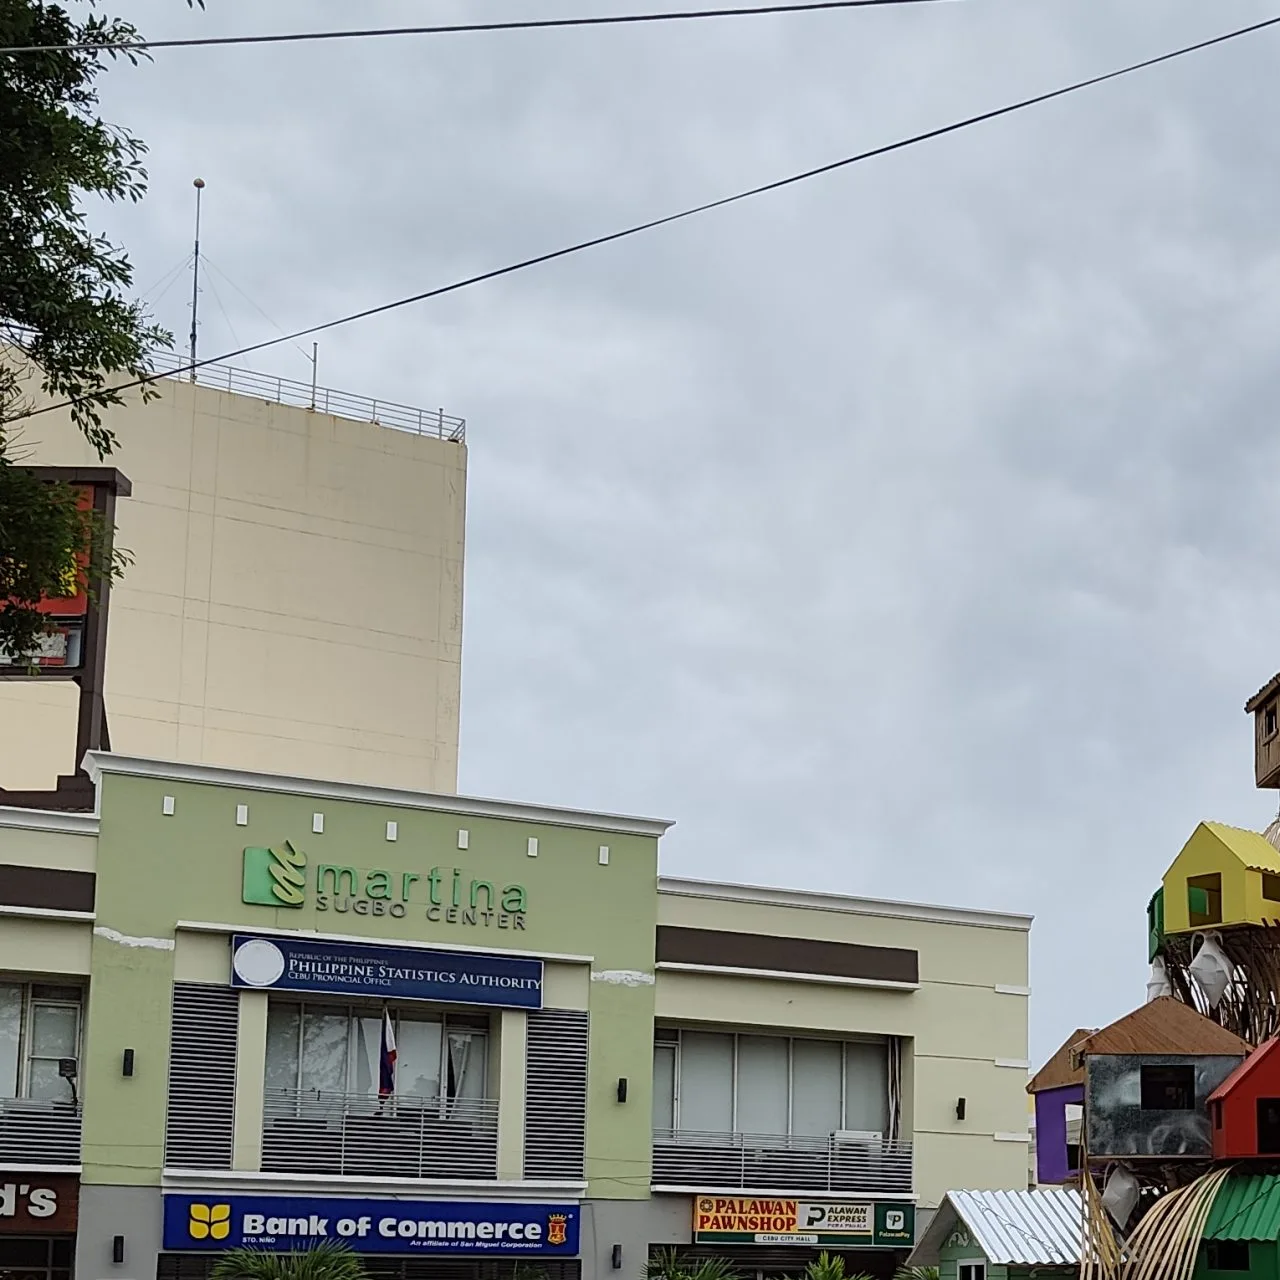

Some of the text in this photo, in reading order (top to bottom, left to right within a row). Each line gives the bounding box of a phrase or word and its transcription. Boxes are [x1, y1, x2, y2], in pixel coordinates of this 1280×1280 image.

[316, 864, 529, 913] martina
[315, 896, 527, 931] SUGBO CENTER
[323, 954, 333, 963] OF
[334, 955, 347, 964] THE
[287, 971, 392, 986] CEBU PROVINCIAL OFFICE
[288, 958, 542, 990] PHILIPPINE STATISTICS AUTHORITY
[715, 1200, 797, 1215] PALAWAN
[699, 1215, 796, 1231] PAWNSHOP
[827, 1215, 867, 1223] EXPRESS
[242, 1214, 542, 1240] Bank of Commerce
[501, 1241, 543, 1249] Corporation
